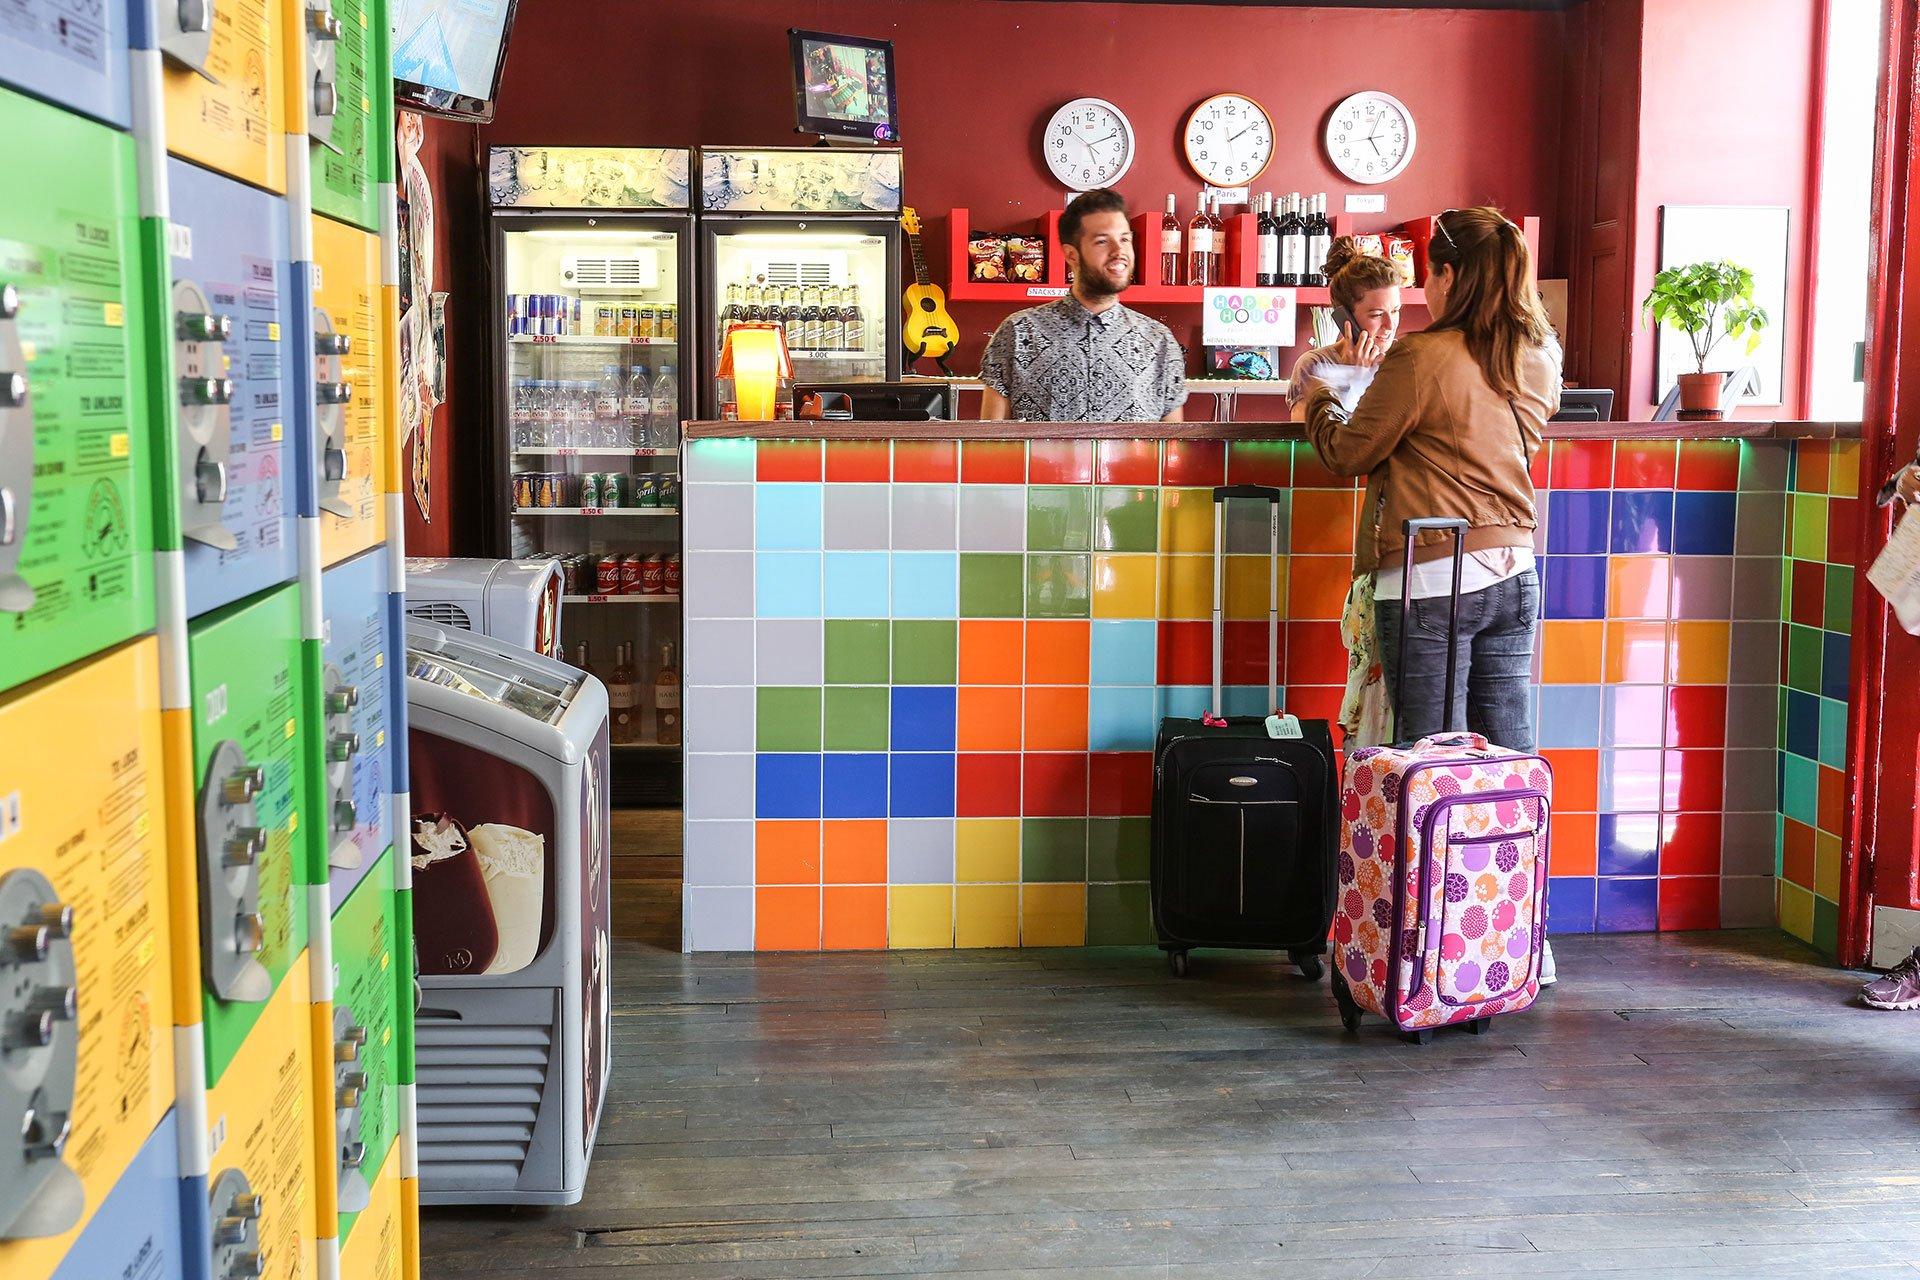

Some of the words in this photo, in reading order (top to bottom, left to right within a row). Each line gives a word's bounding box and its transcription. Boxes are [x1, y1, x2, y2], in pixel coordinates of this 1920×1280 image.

[1210, 110, 1220, 119] 11
[1224, 105, 1236, 116] 12
[1242, 110, 1247, 119] 1
[1352, 110, 1360, 119] 11
[1365, 105, 1375, 115] 12
[1381, 110, 1386, 118] 1
[1072, 116, 1080, 125] 11
[1085, 112, 1096, 122] 12
[1102, 118, 1106, 127] 1
[1200, 120, 1214, 130] 10
[1251, 121, 1259, 131] 2
[1342, 121, 1353, 131] 10
[1390, 119, 1397, 129] 2
[1061, 126, 1072, 136] 10
[1110, 128, 1118, 137] 2
[1056, 138, 1064, 148] 9
[1196, 135, 1205, 145] 9
[1255, 136, 1263, 145] 3
[1339, 134, 1346, 144] 9
[1394, 133, 1402, 143] 3
[1113, 142, 1121, 152] 3
[1199, 150, 1208, 160] 8
[1251, 152, 1259, 160] 4
[1343, 148, 1351, 158] 8
[1391, 148, 1397, 157] 4
[1060, 153, 1068, 163] 8
[1109, 157, 1115, 167] 4
[1354, 158, 1360, 167] 7
[1381, 157, 1388, 167] 5
[1070, 164, 1077, 174] 7
[1098, 166, 1105, 176] 5
[1210, 161, 1217, 171] 7
[1225, 165, 1234, 176] 6
[1241, 162, 1248, 172] 5
[1366, 162, 1374, 172] 6
[1083, 169, 1090, 179] 6
[1028, 288, 1056, 296] SNACKS
[1220, 308, 1278, 324] HOUR
[636, 485, 657, 500] Sprite
